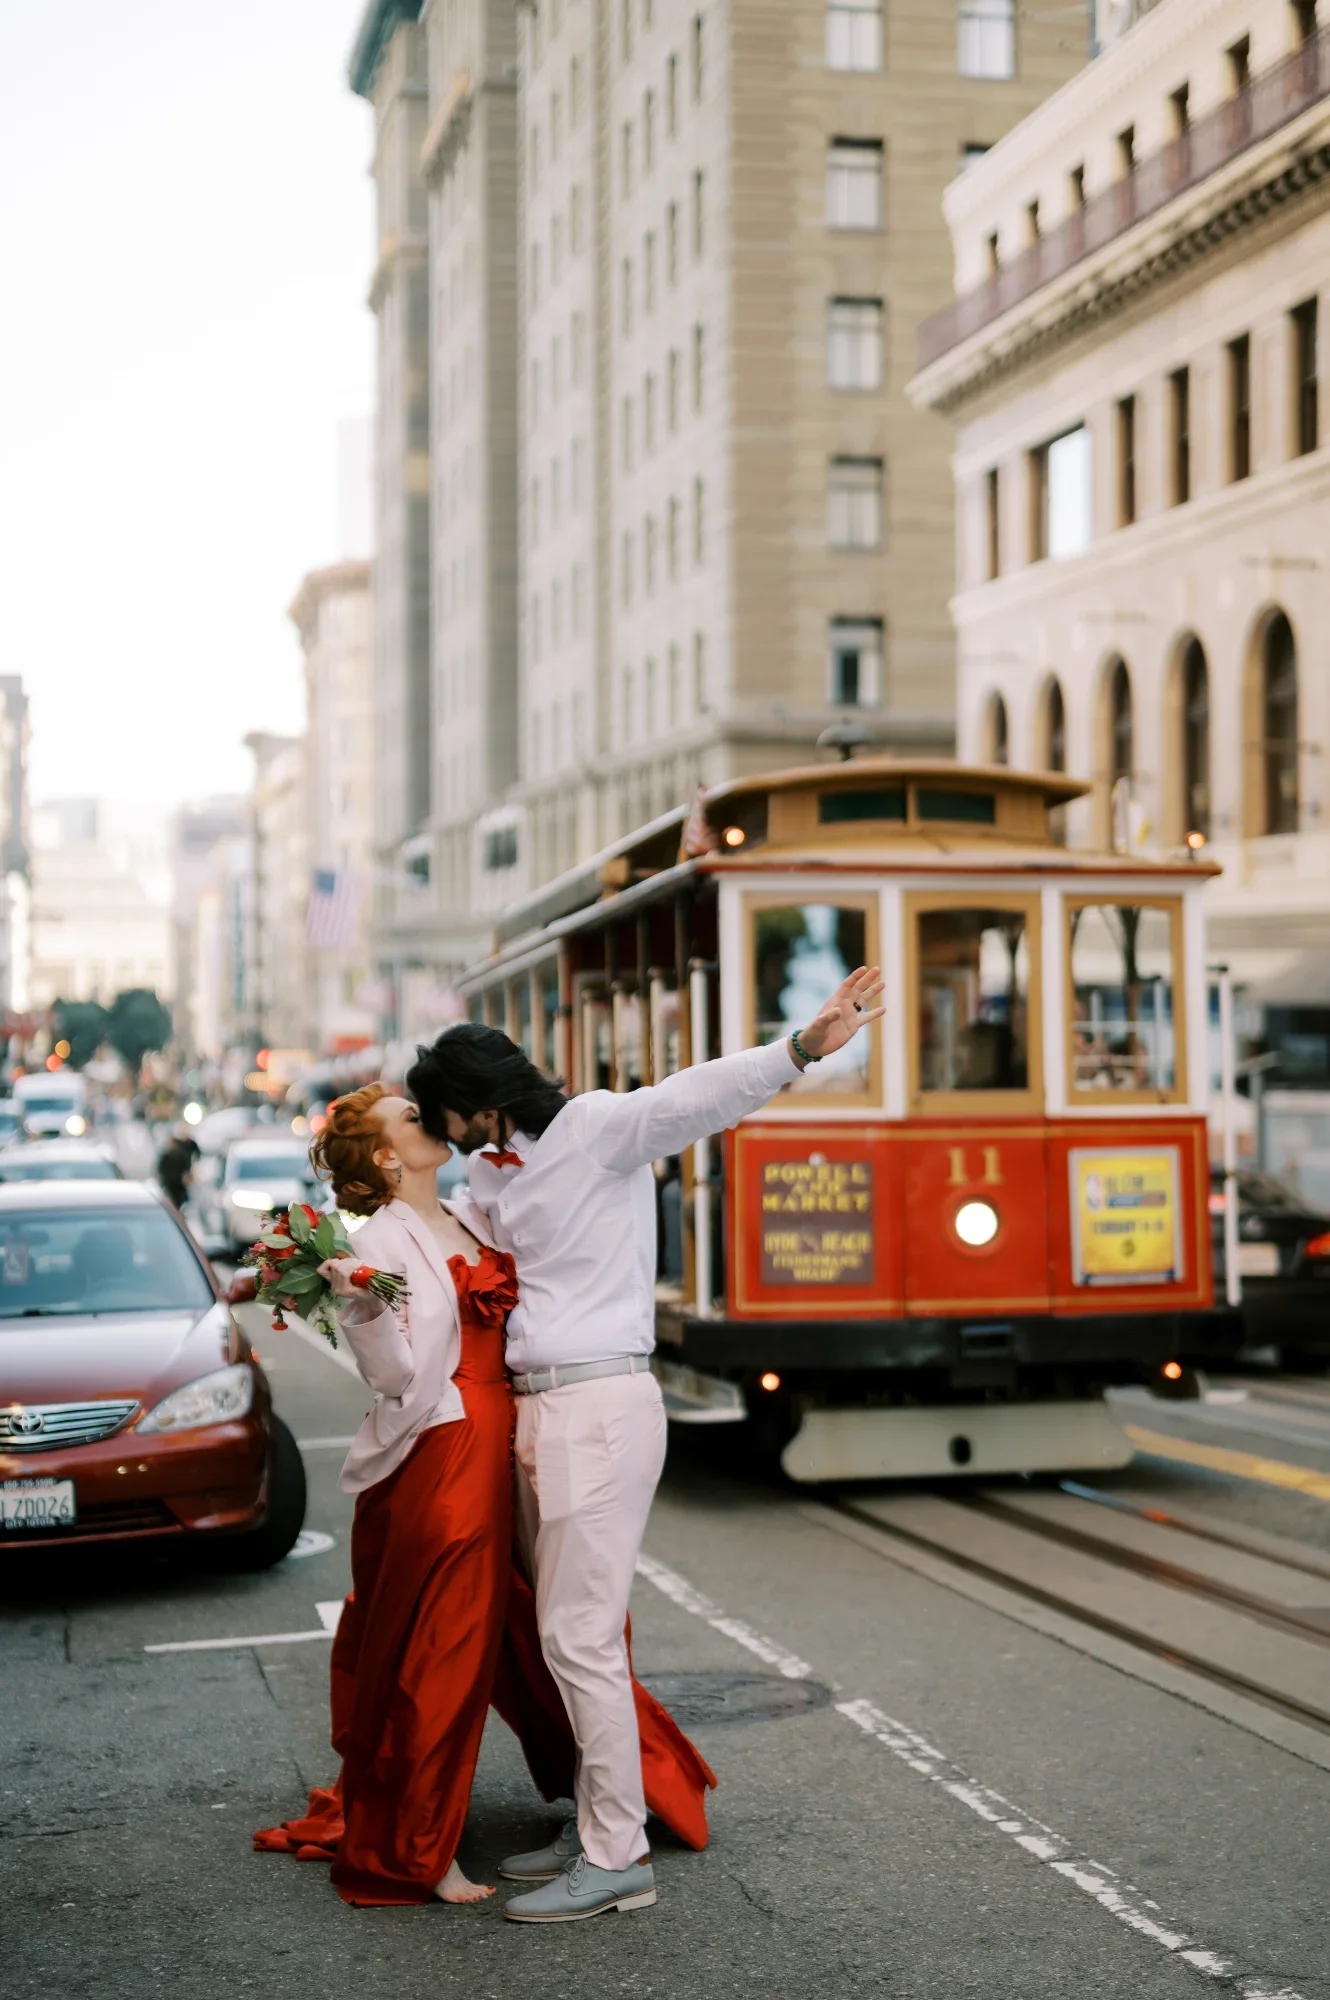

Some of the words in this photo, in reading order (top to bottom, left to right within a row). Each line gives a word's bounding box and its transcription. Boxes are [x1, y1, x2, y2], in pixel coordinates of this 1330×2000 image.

[764, 1164, 868, 1185] POWELL
[946, 1146, 1004, 1185] 11
[762, 1192, 869, 1213] MARKET
